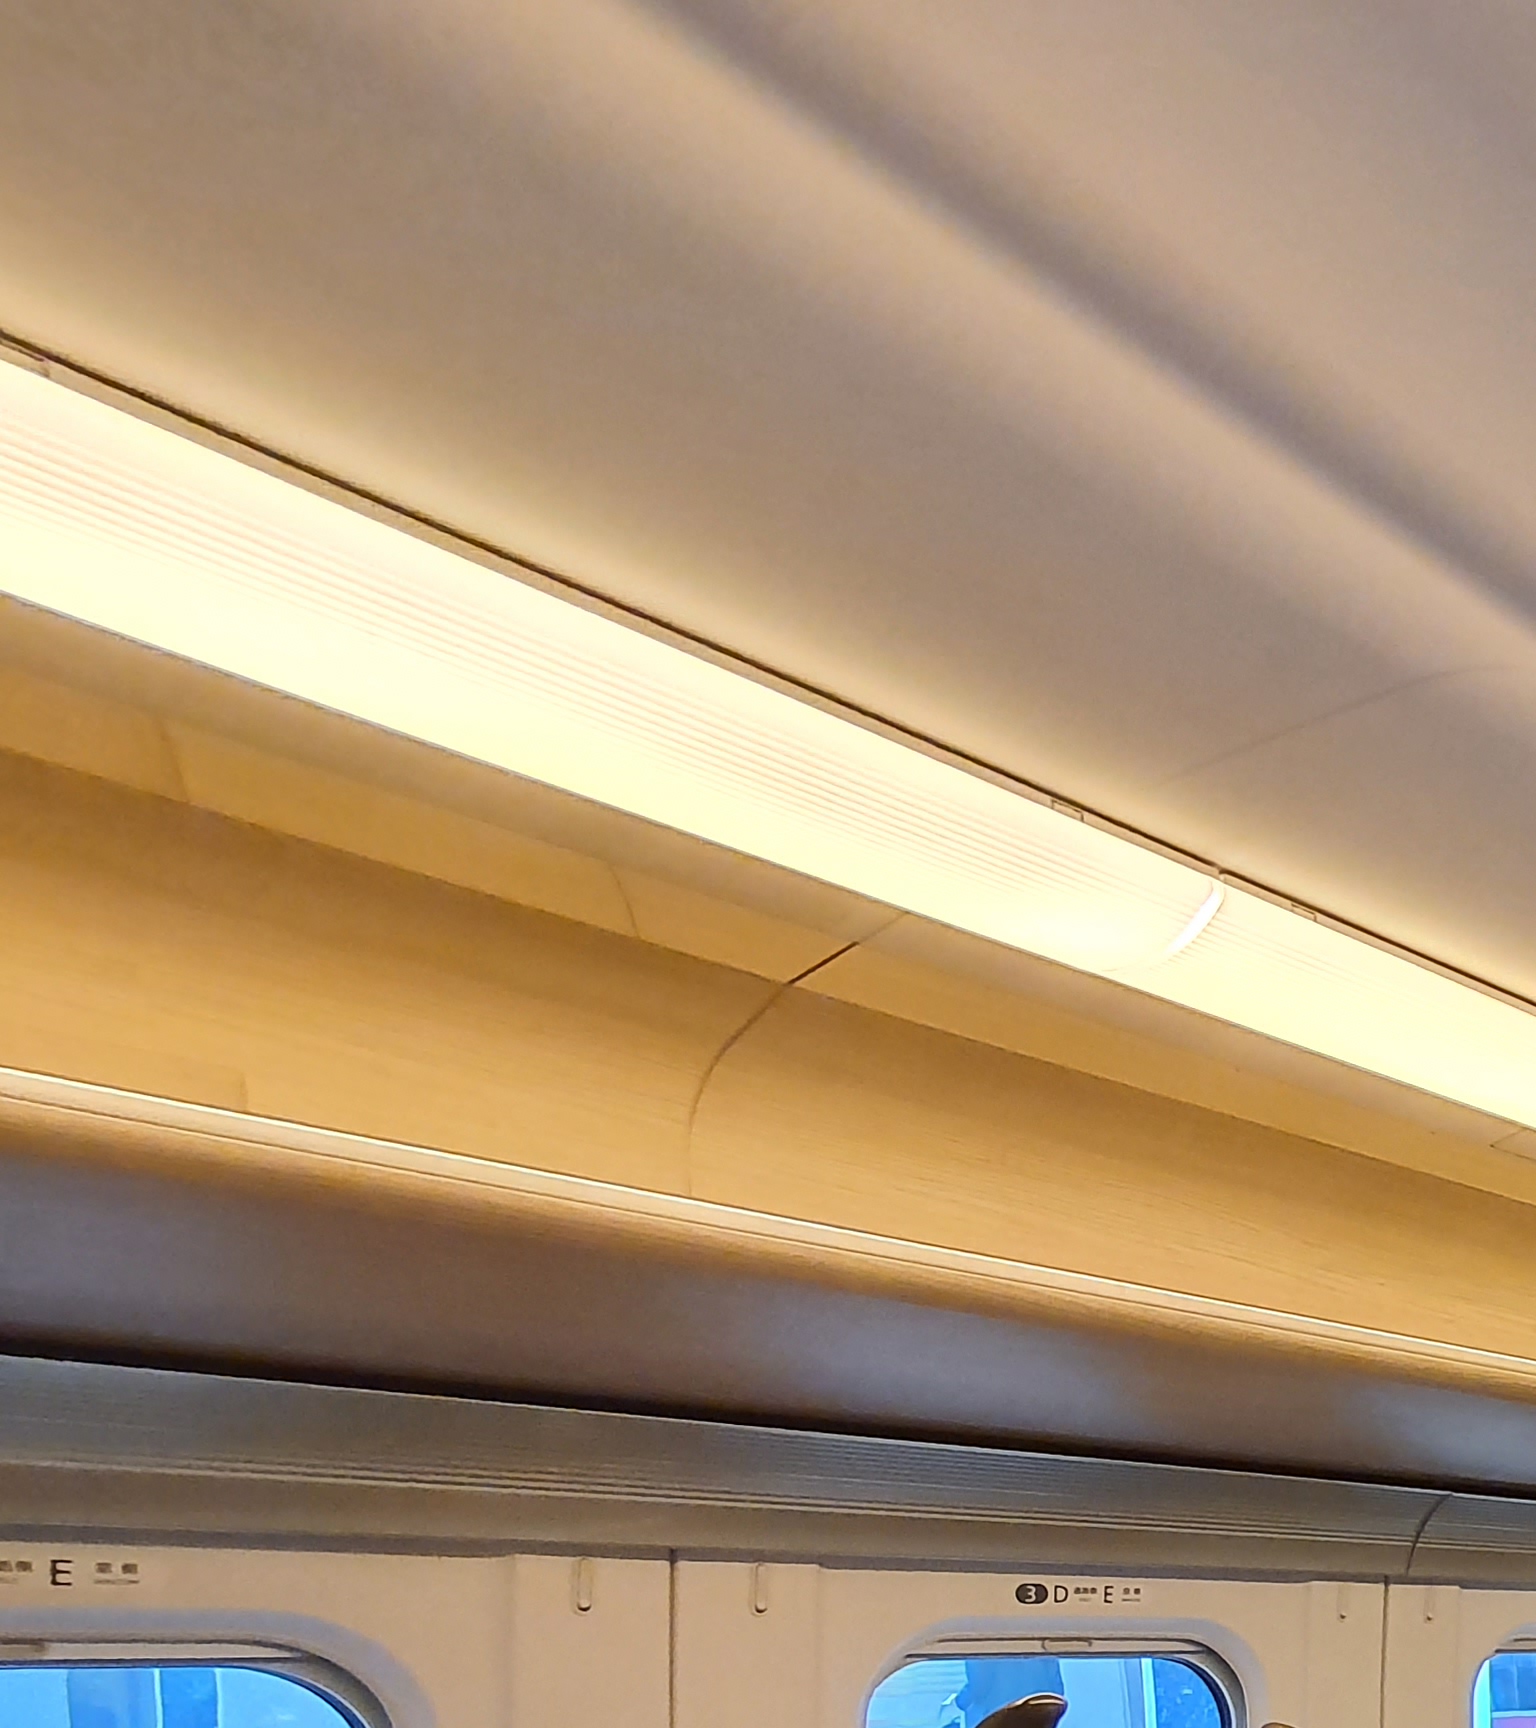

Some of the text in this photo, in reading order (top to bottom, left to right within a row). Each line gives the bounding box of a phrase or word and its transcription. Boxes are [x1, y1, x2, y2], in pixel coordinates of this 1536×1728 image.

[50, 1559, 73, 1586] E
[1025, 1585, 1037, 1602] 3
[1053, 1585, 1069, 1603] D
[1103, 1585, 1114, 1603] E
